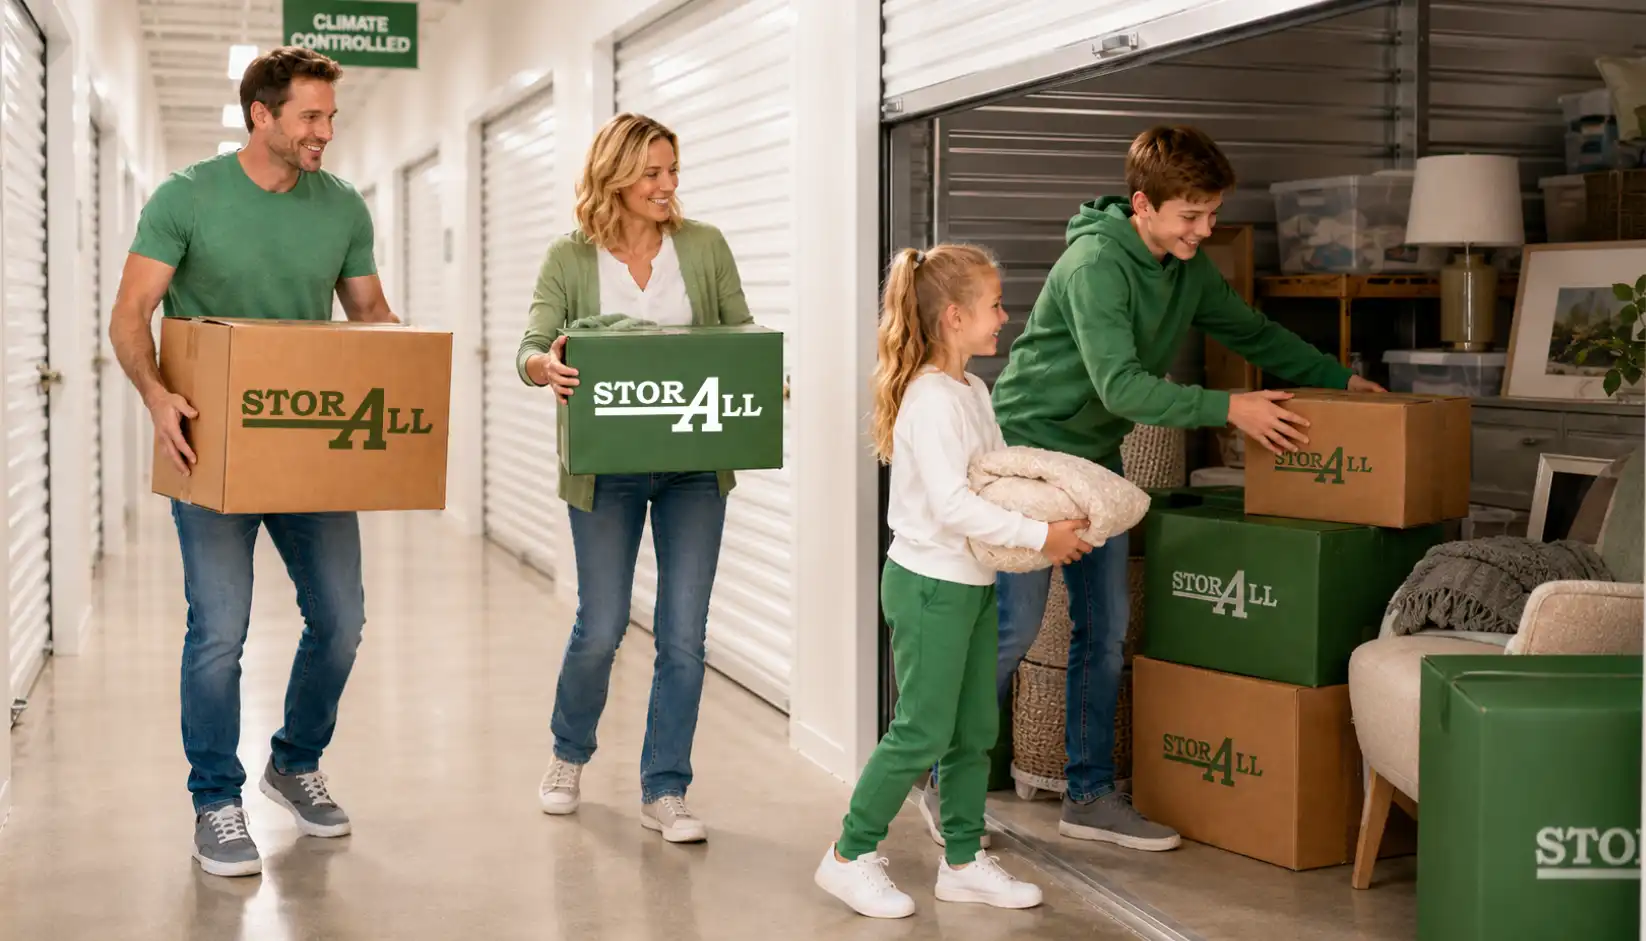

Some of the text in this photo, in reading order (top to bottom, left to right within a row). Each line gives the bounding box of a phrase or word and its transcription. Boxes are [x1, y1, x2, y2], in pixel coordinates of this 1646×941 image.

[313, 13, 389, 33] CLIMATE
[291, 32, 411, 53] CONTROLLED
[1535, 826, 1641, 866] STO
